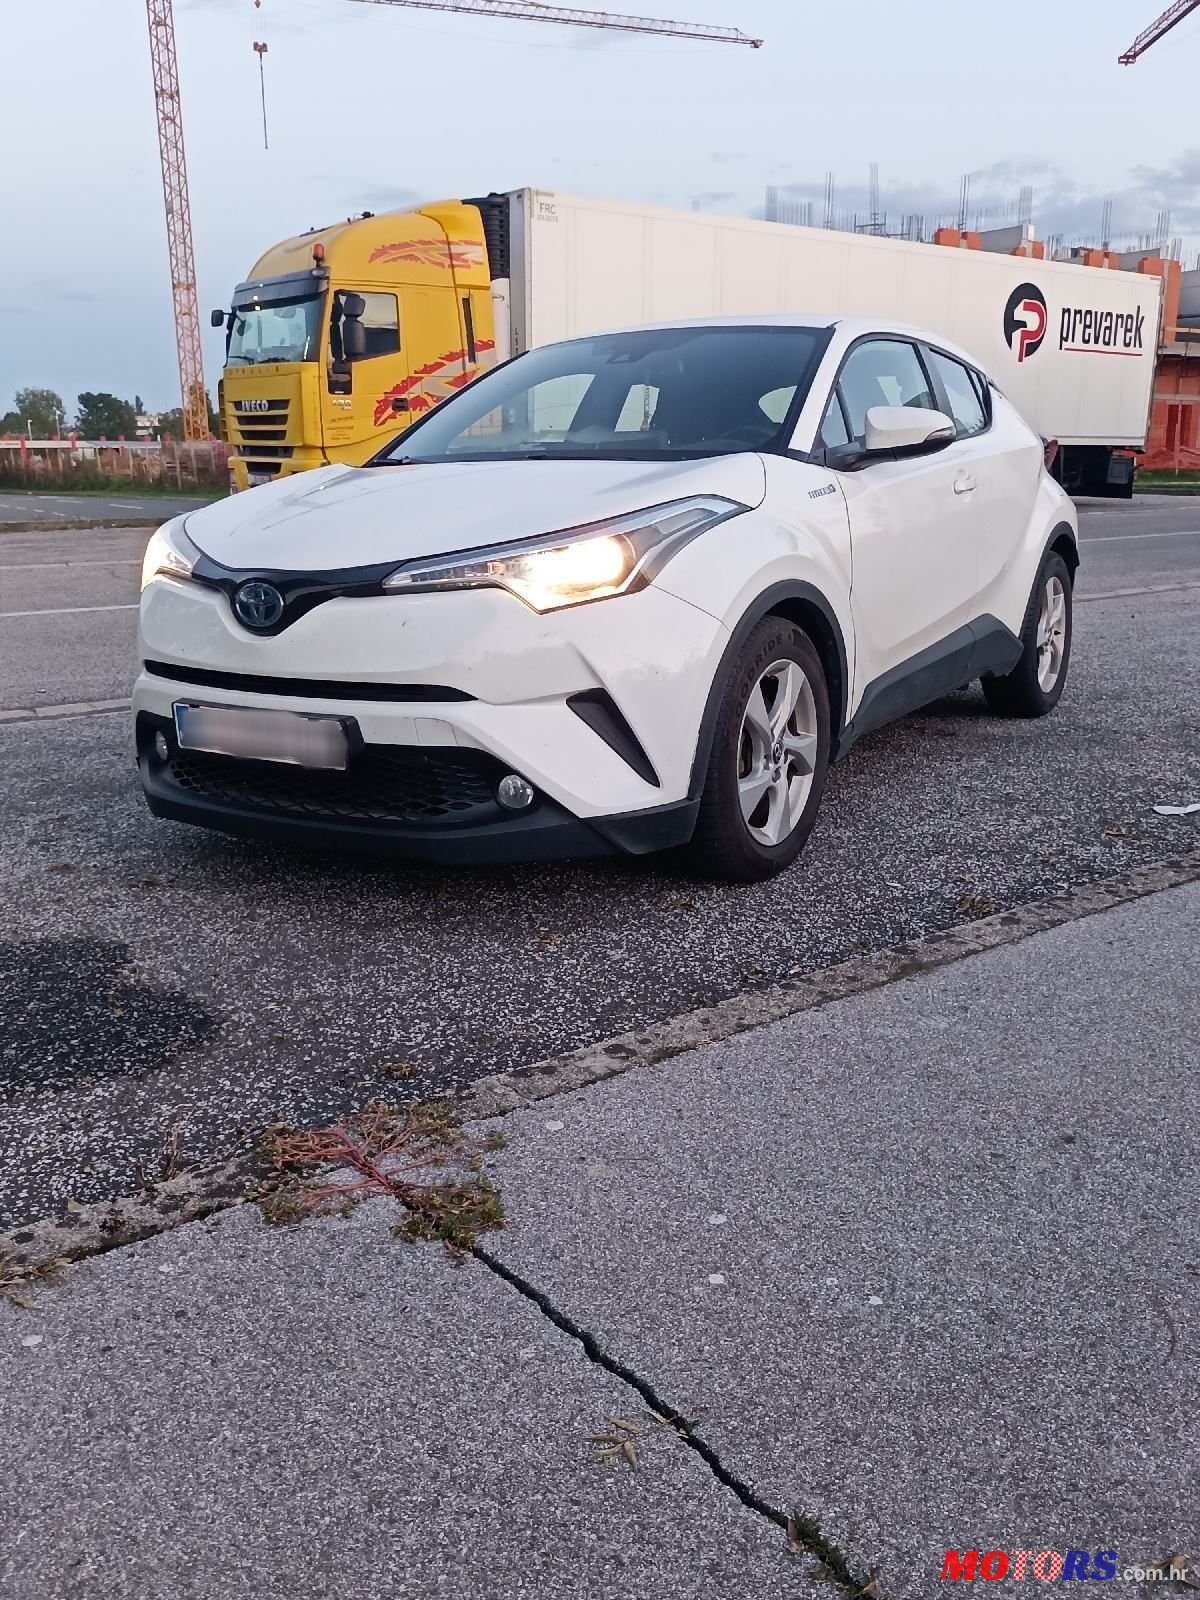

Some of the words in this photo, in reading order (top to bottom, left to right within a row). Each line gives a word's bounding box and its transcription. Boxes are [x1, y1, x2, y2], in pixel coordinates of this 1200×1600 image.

[539, 203, 556, 214] FRC
[1059, 305, 1145, 350] prevarek
[241, 400, 269, 412] IVECO
